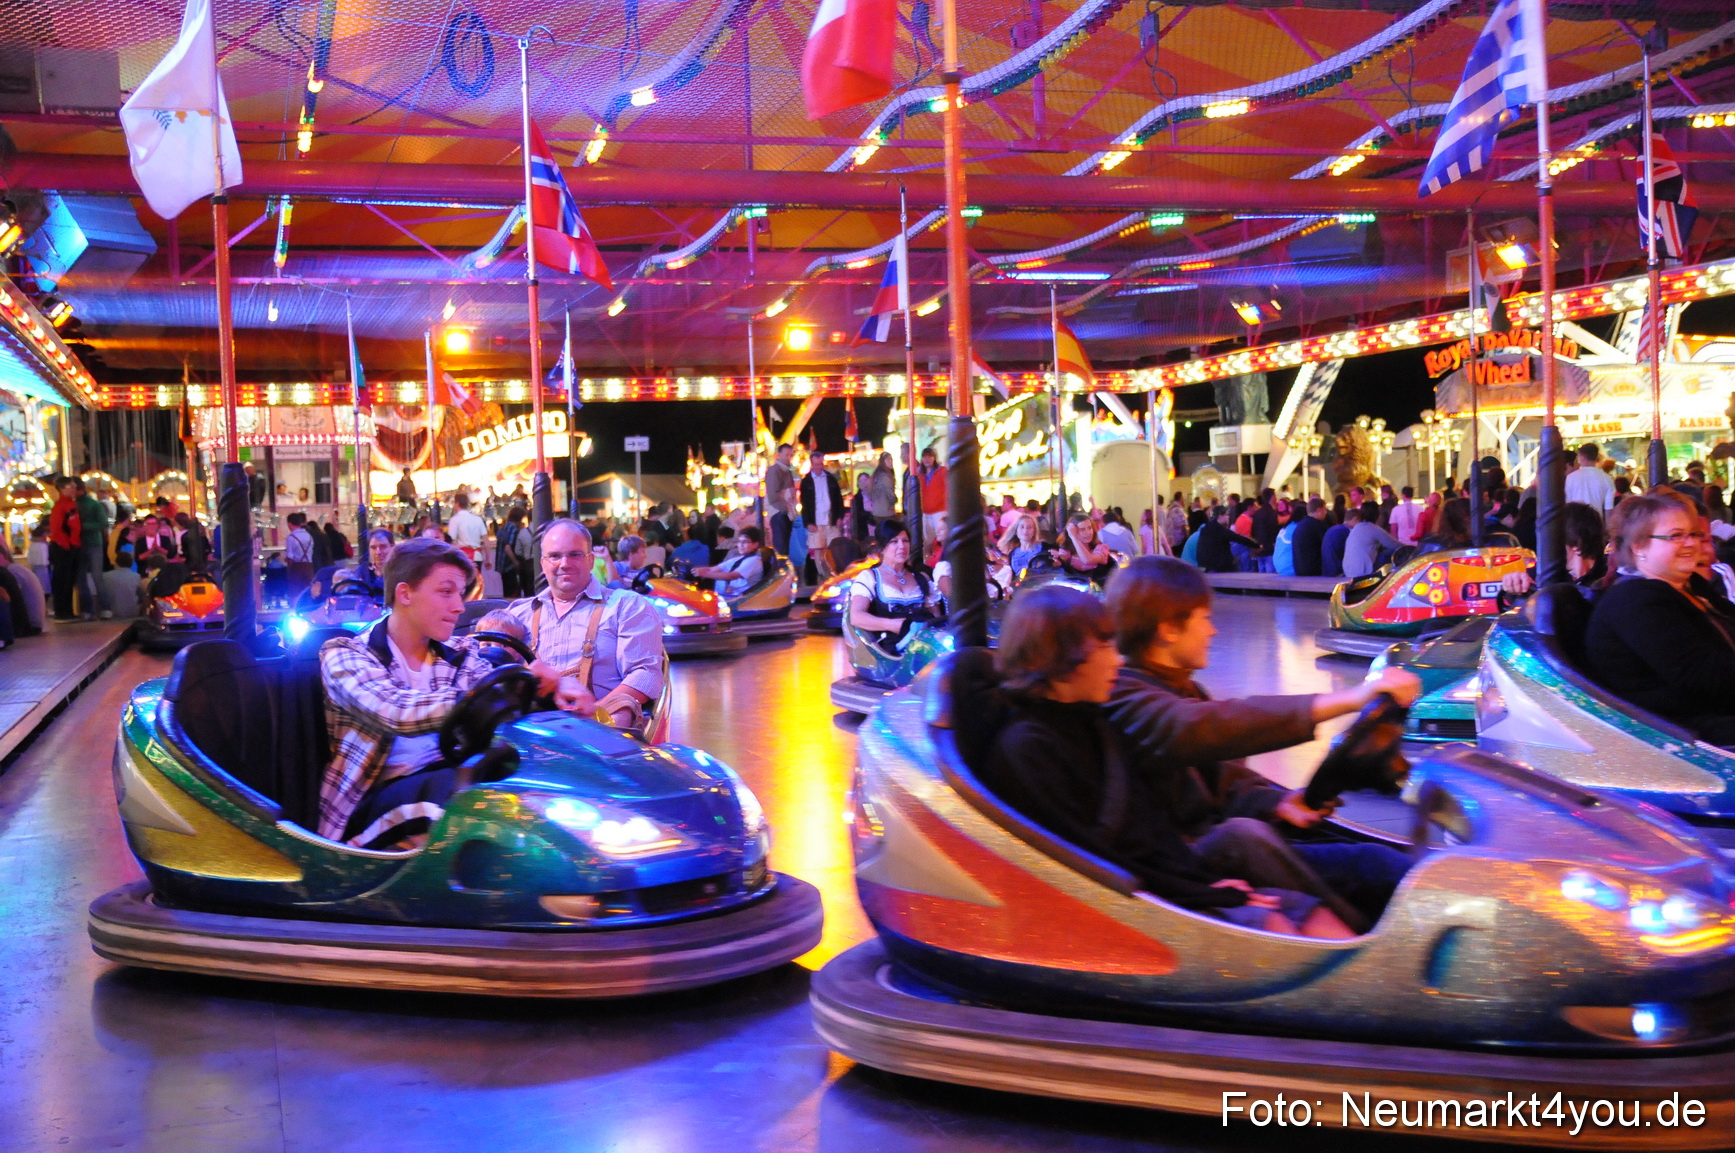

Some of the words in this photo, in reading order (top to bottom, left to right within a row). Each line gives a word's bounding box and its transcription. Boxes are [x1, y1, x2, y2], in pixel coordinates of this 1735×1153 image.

[1423, 337, 1480, 377] Royal
[1483, 328, 1578, 359] Bavaran
[1465, 355, 1531, 385] Wheel
[460, 410, 567, 460] DOMINO
[1582, 421, 1623, 434] KASSE
[1679, 417, 1723, 428] KASSE
